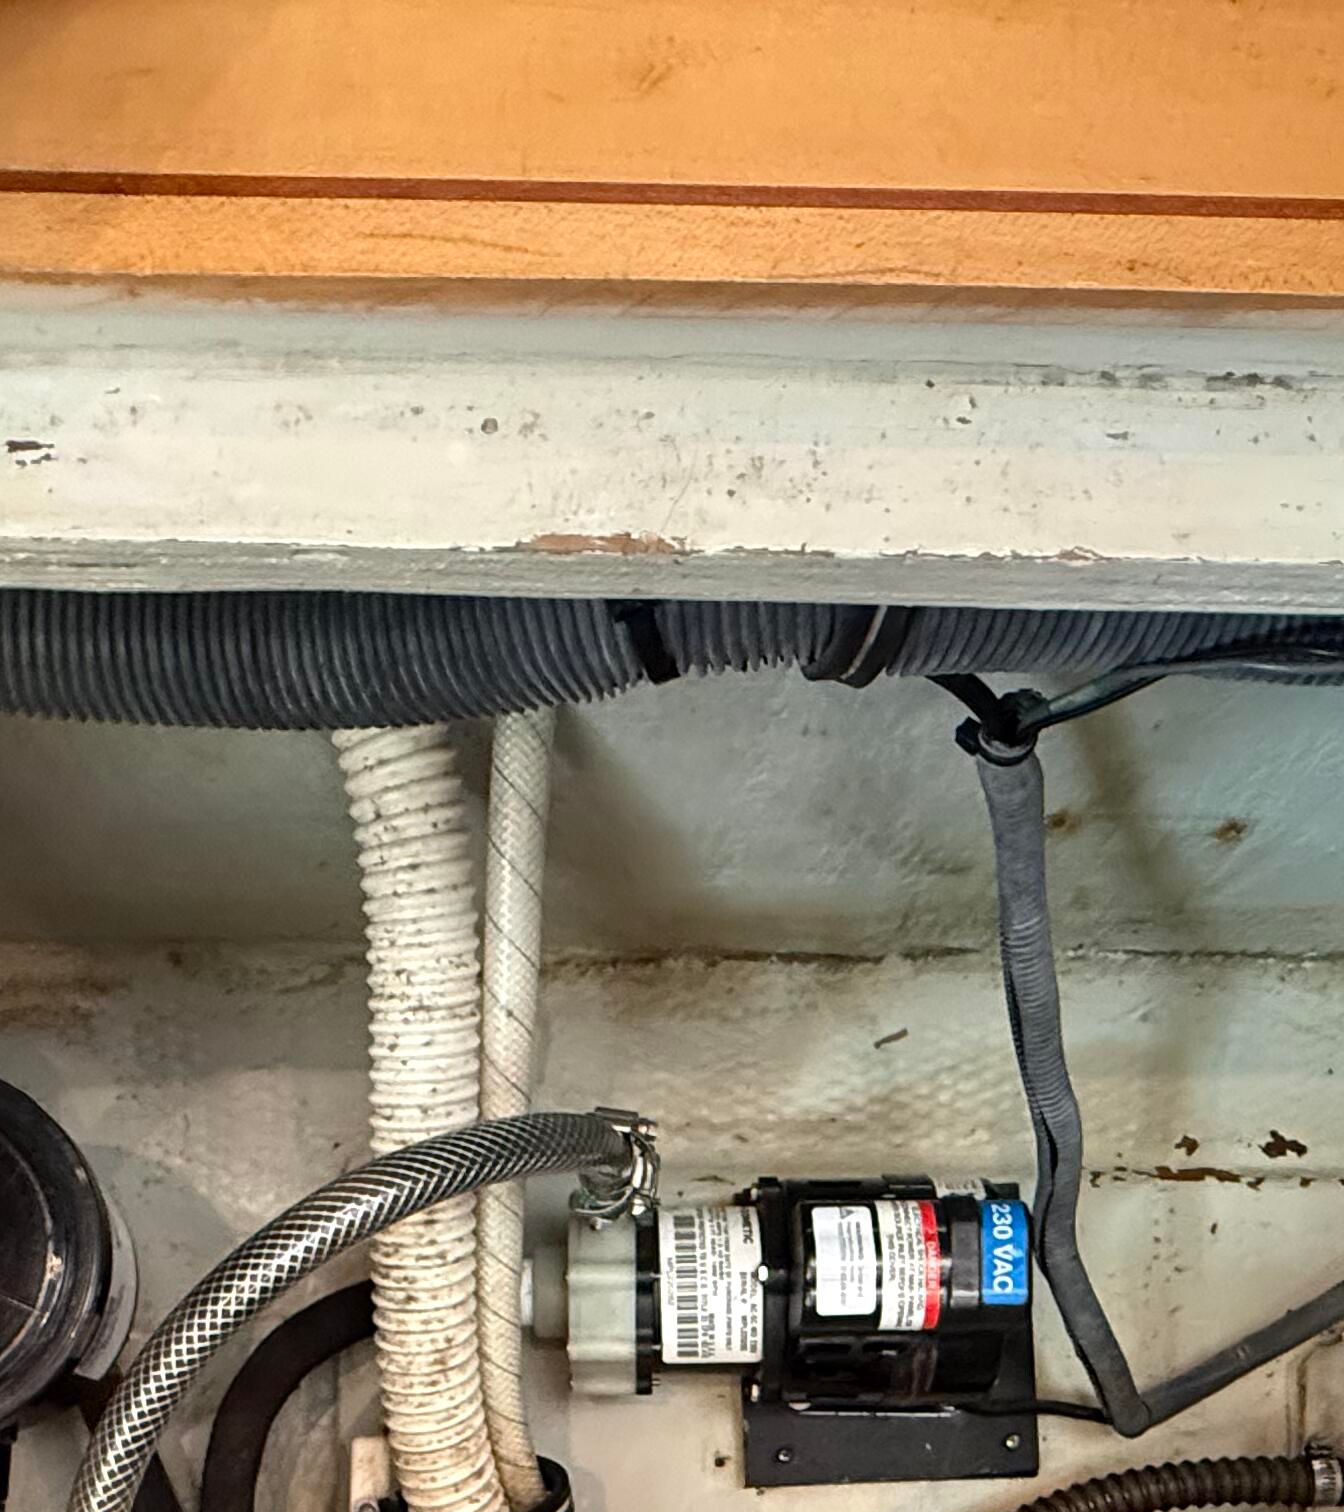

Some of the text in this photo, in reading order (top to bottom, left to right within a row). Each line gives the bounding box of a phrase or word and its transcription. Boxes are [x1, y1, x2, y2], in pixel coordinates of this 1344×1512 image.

[926, 1241, 939, 1290] DANGER
[990, 1203, 1015, 1293] 230 VAC
